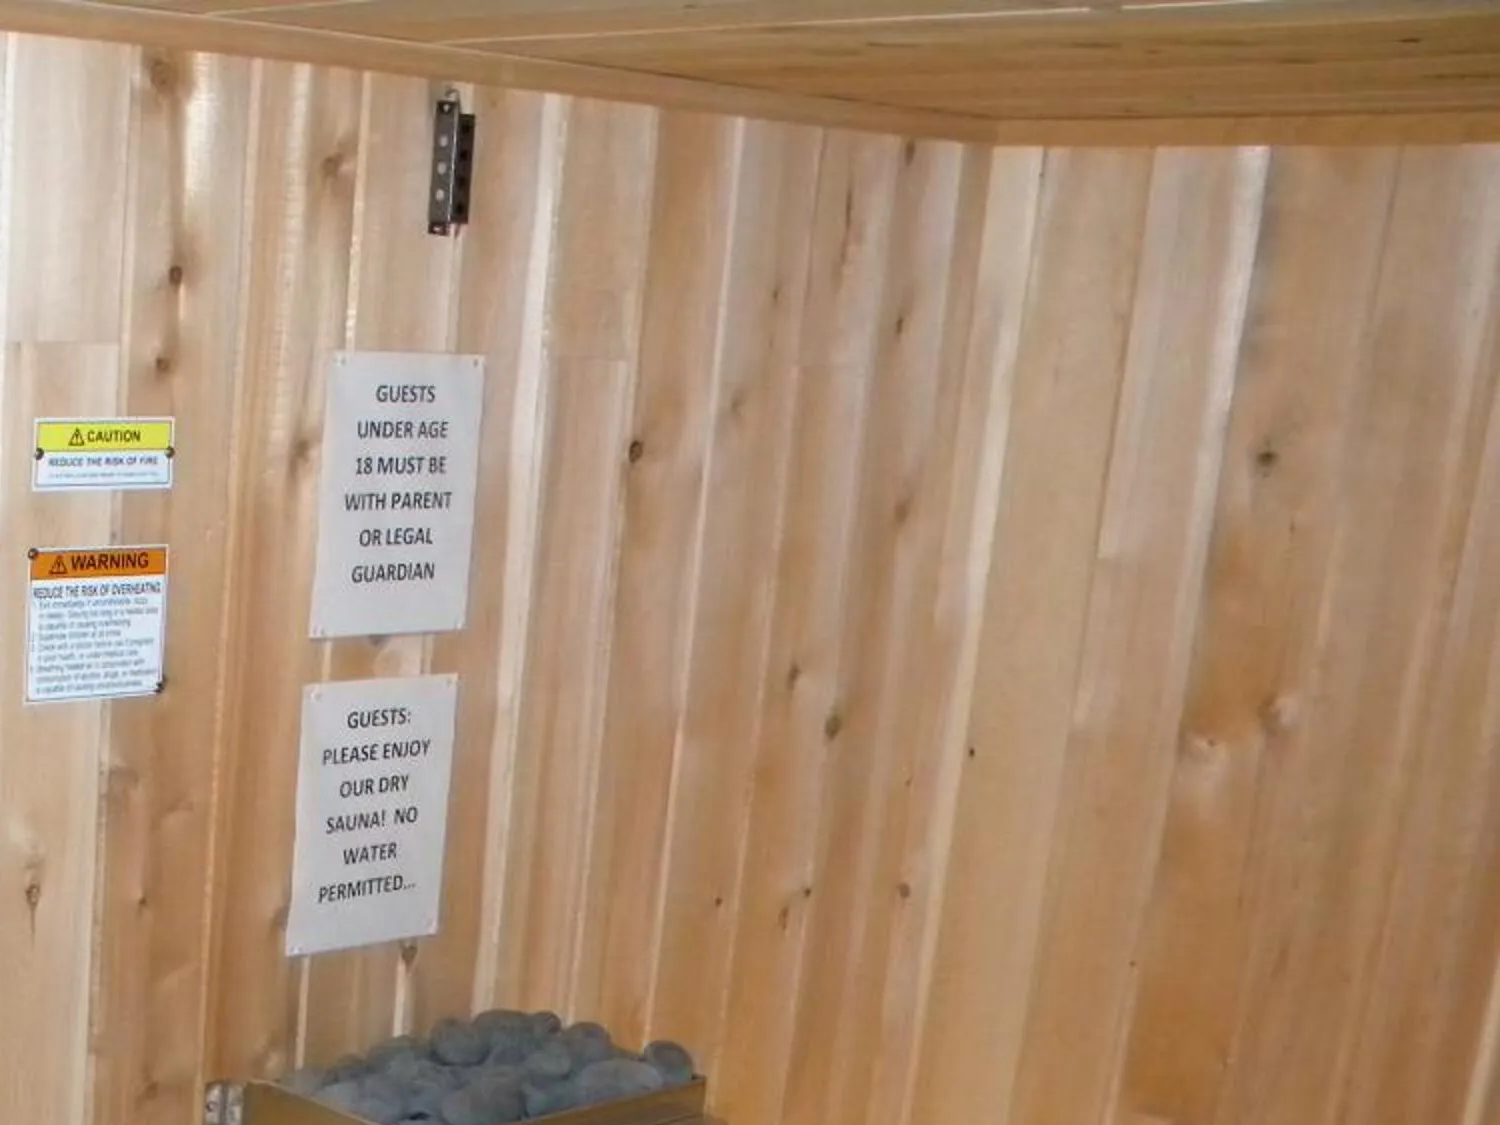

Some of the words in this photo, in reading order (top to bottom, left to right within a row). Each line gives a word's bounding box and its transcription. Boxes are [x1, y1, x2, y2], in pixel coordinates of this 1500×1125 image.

[376, 385, 435, 403] GUESTS
[87, 430, 141, 442] CAUTION
[357, 421, 412, 439] UNDER
[417, 421, 448, 439] AGE
[49, 456, 83, 467] REDUCE
[87, 456, 102, 466] THE
[104, 456, 125, 465] RISK
[126, 456, 137, 465] OF
[139, 455, 157, 465] FIRE
[356, 457, 373, 475] 18
[377, 456, 423, 475] MUST
[428, 456, 447, 473] BE
[344, 493, 386, 511] WITH
[391, 492, 452, 510] PARENT
[359, 529, 381, 547] OR
[386, 528, 433, 545] LEGAL
[71, 552, 149, 570] WARNING
[351, 563, 435, 584] GUARDIAN
[34, 586, 63, 599] REDUCE
[66, 586, 79, 598] THE
[82, 585, 99, 597] RISK
[100, 584, 109, 596] OF
[347, 707, 412, 729] GUESTS:
[322, 743, 379, 765] PLEASE
[383, 739, 431, 760] ENJOY
[339, 778, 374, 799] OUR
[378, 775, 409, 794] DRY
[325, 809, 386, 834] SAUNA!
[393, 806, 419, 825] NO
[343, 843, 398, 865] WATER
